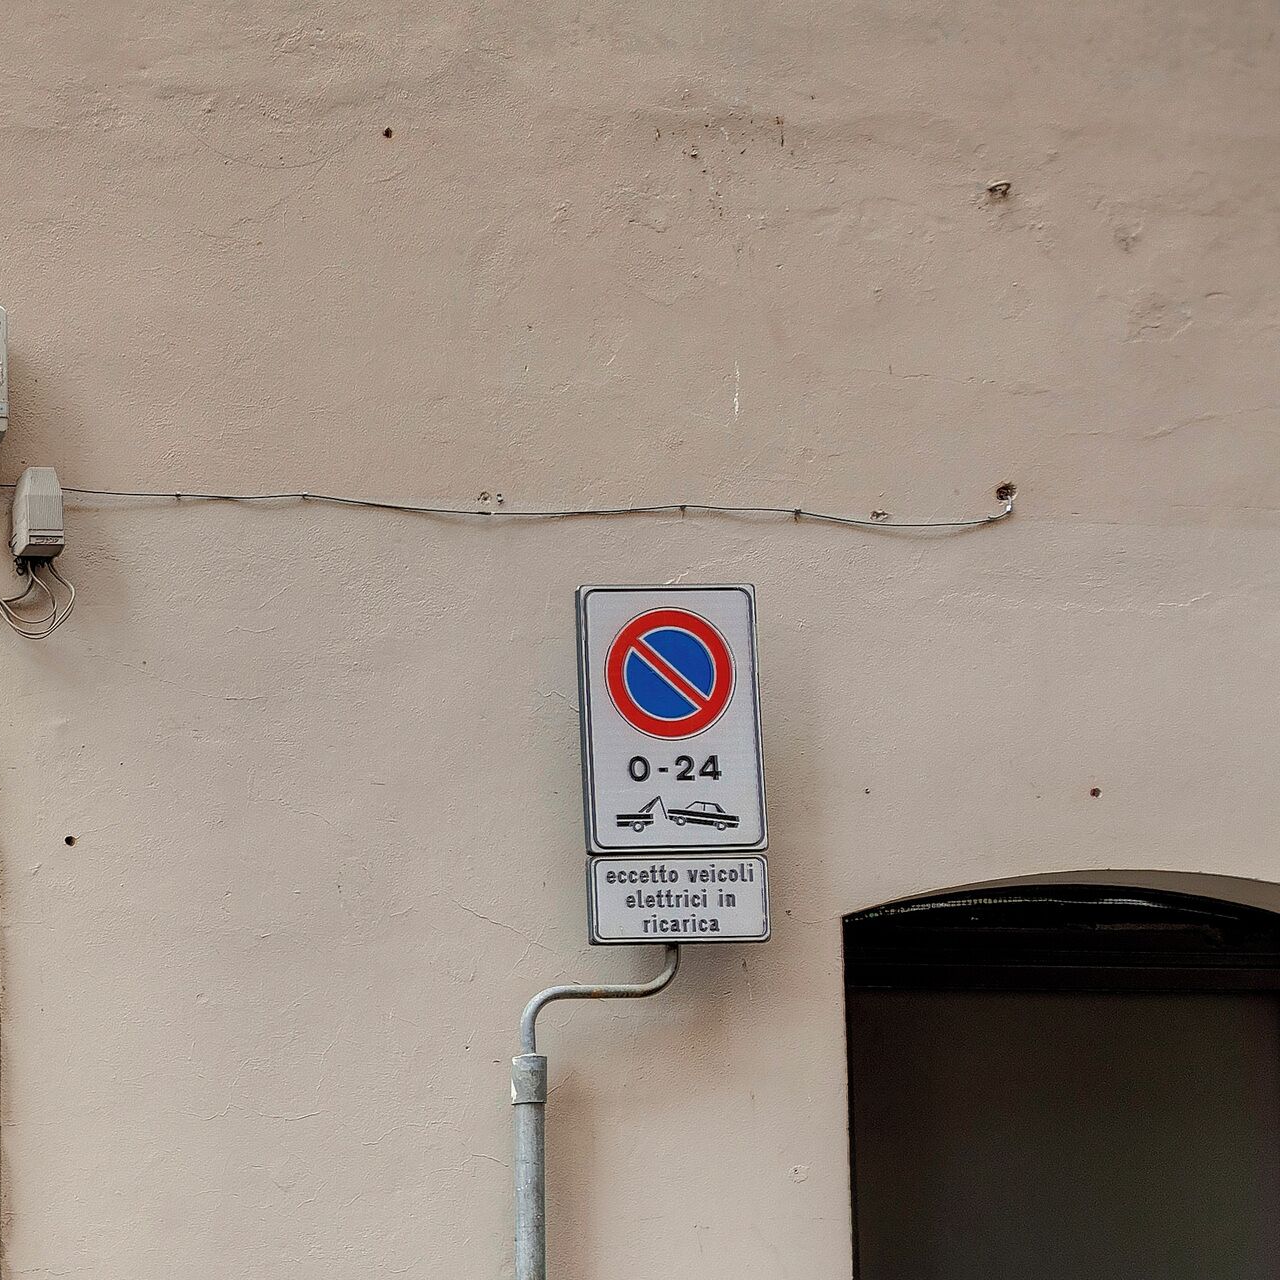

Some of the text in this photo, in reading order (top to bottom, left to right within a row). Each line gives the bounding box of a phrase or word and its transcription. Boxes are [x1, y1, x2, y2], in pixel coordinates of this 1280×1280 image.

[628, 754, 723, 783] 0-24
[606, 863, 755, 884] eccetto veicoli
[625, 889, 736, 908] elettrici in
[642, 914, 720, 933] ricarica
